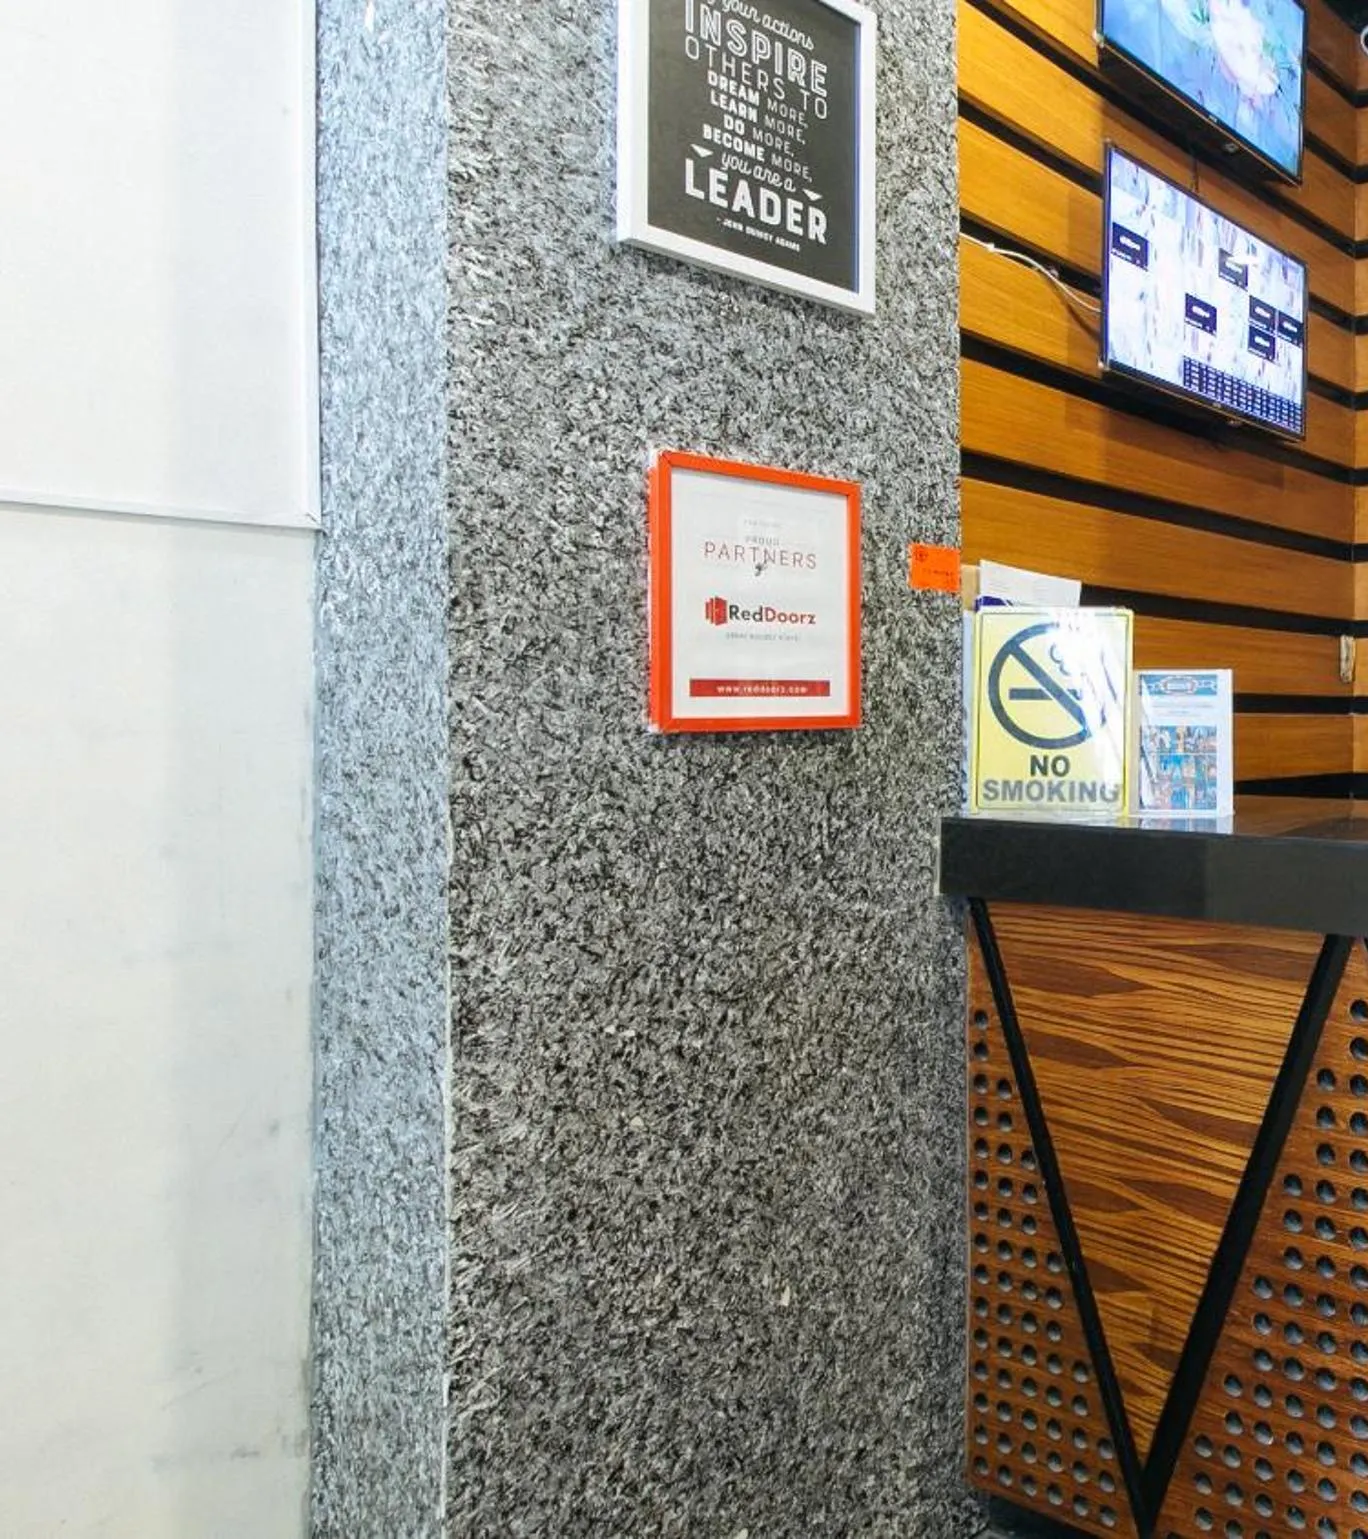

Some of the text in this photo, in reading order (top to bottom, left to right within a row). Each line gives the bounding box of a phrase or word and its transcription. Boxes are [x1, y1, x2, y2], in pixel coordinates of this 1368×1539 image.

[685, 0, 827, 97] INSPIRE
[762, 14, 814, 50] actions
[685, 35, 827, 119] OTHERS TO
[707, 70, 760, 106] DREAM
[711, 90, 806, 145] LEARN MORE,
[724, 114, 794, 157] DO MORE,
[703, 124, 812, 183] BECOME MORE,
[721, 152, 796, 192] you are a
[685, 158, 827, 245] LEADER
[703, 540, 817, 570] PARTNERS
[728, 604, 817, 625] RedDoorz
[1030, 754, 1070, 777] NO
[982, 779, 1119, 803] SMOKING
